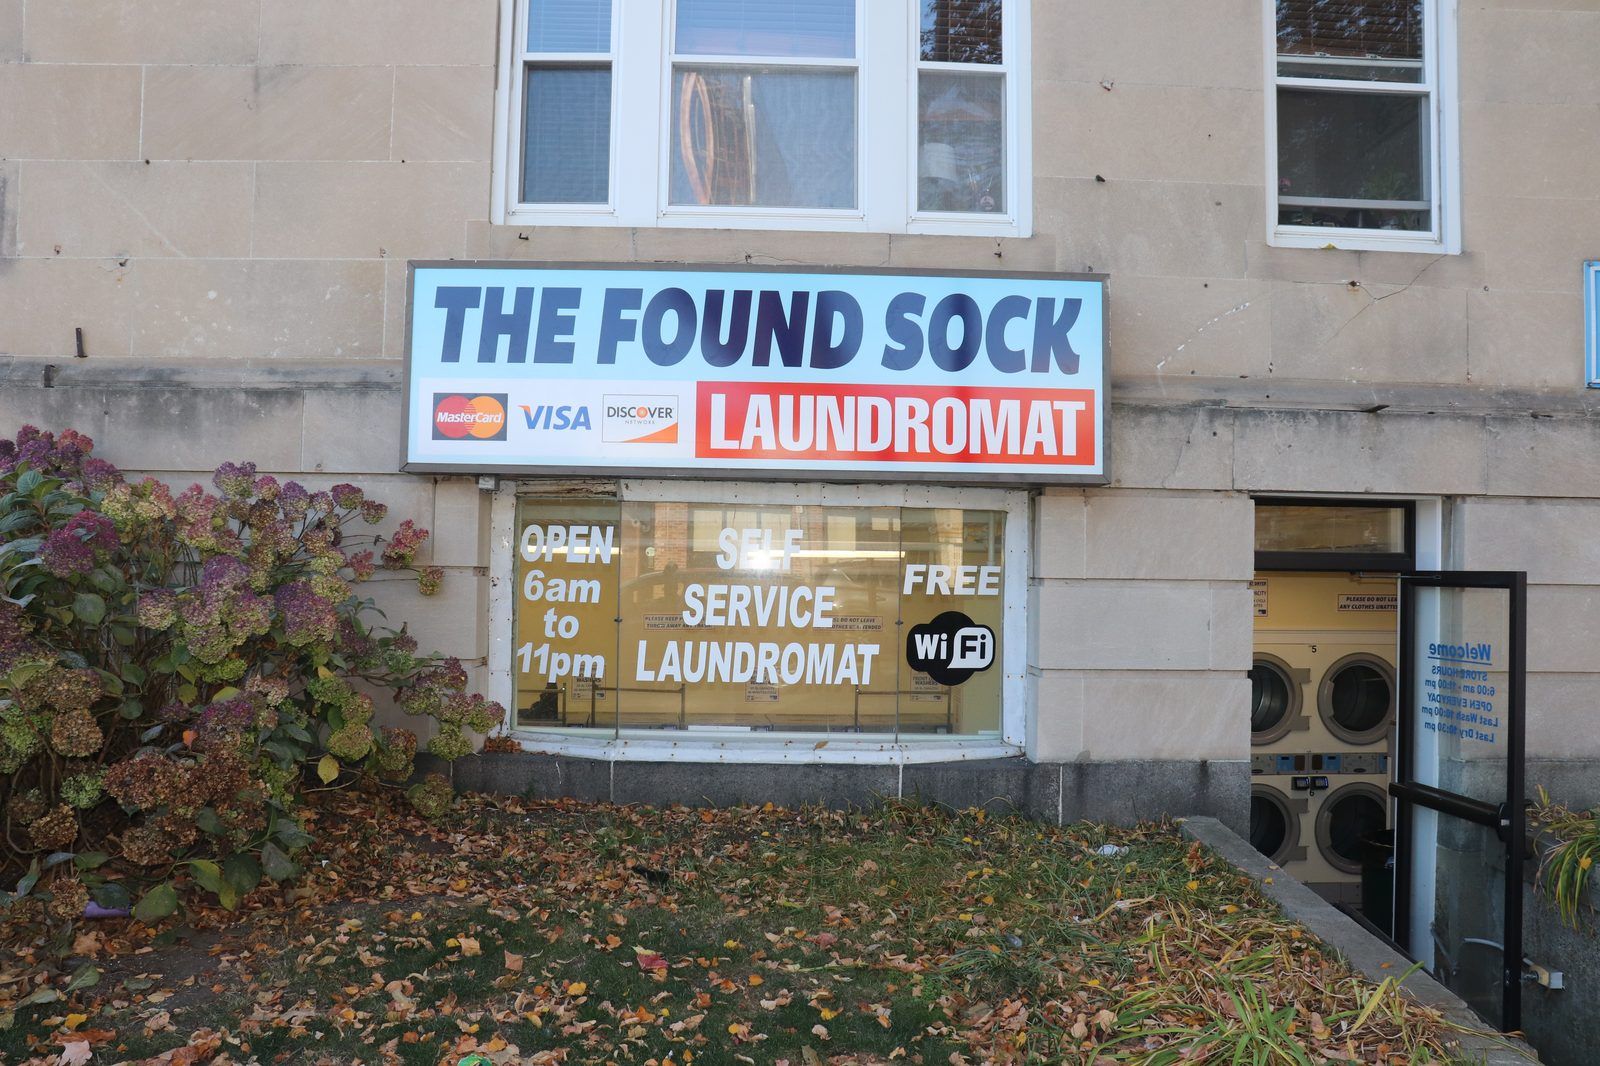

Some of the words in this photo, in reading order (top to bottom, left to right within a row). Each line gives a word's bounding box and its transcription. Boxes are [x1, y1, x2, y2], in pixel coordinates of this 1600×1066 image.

[434, 286, 582, 364] THE
[597, 287, 864, 370] FOUND
[881, 292, 1083, 375] SOCK
[437, 411, 502, 424] MasterCard
[518, 405, 592, 431] VISA
[607, 406, 673, 418] DISCOVER
[710, 393, 1086, 457] LAUNDROMAT
[520, 524, 614, 564] OPEN
[716, 528, 803, 570] SELF
[523, 569, 601, 604] 6am
[903, 564, 1001, 596] FREE
[544, 607, 580, 639] to
[682, 583, 835, 628] SERVICE
[517, 642, 605, 683] 11pm
[635, 640, 880, 685] LAUNDROMAT
[914, 632, 986, 660] WiFi
[1311, 645, 1317, 654] 5
